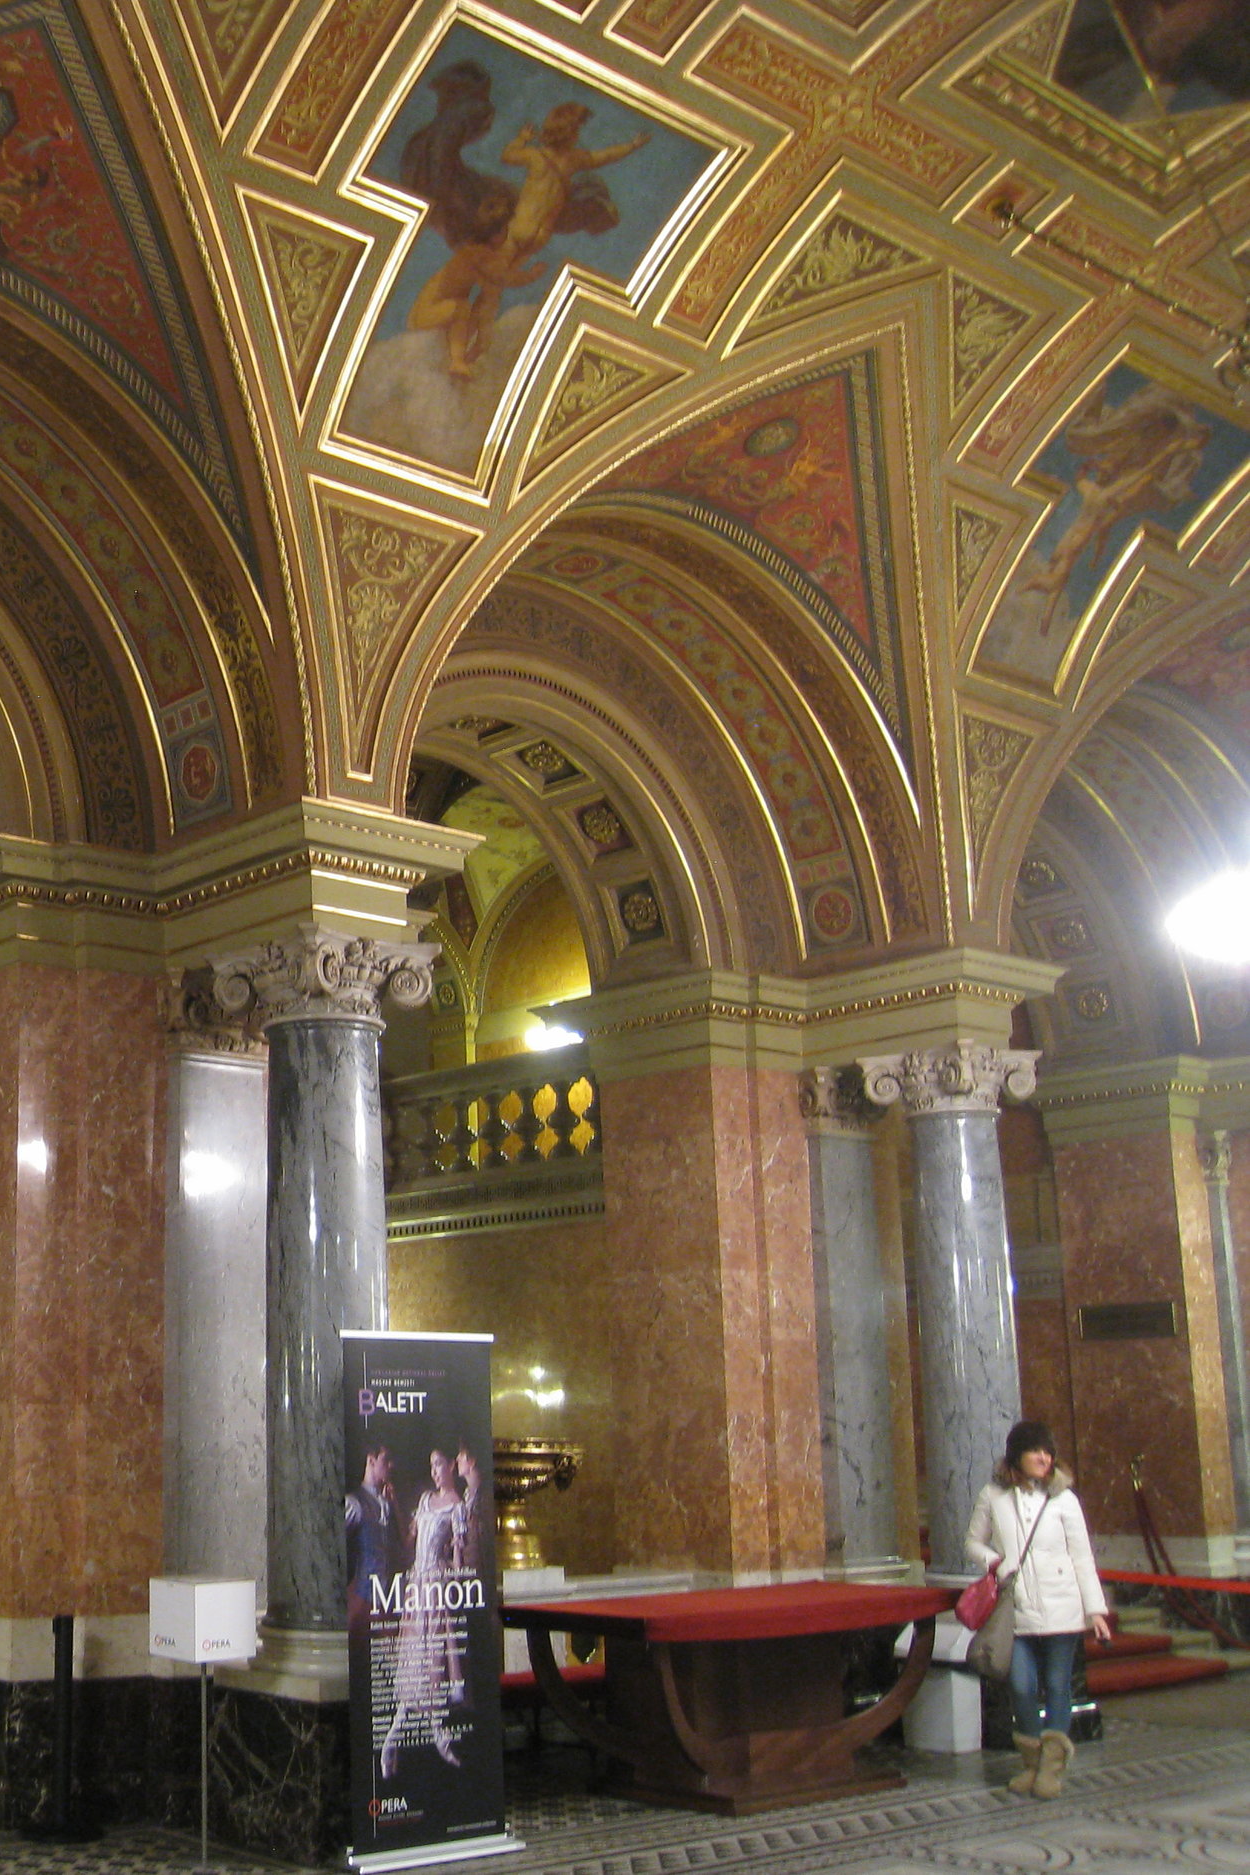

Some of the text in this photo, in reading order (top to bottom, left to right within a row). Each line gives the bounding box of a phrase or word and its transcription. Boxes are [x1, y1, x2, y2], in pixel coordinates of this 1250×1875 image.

[358, 1389, 427, 1416] BALETT
[369, 1572, 486, 1616] Manon
[202, 1639, 231, 1651] OPERA
[368, 1796, 408, 1816] OPERA
